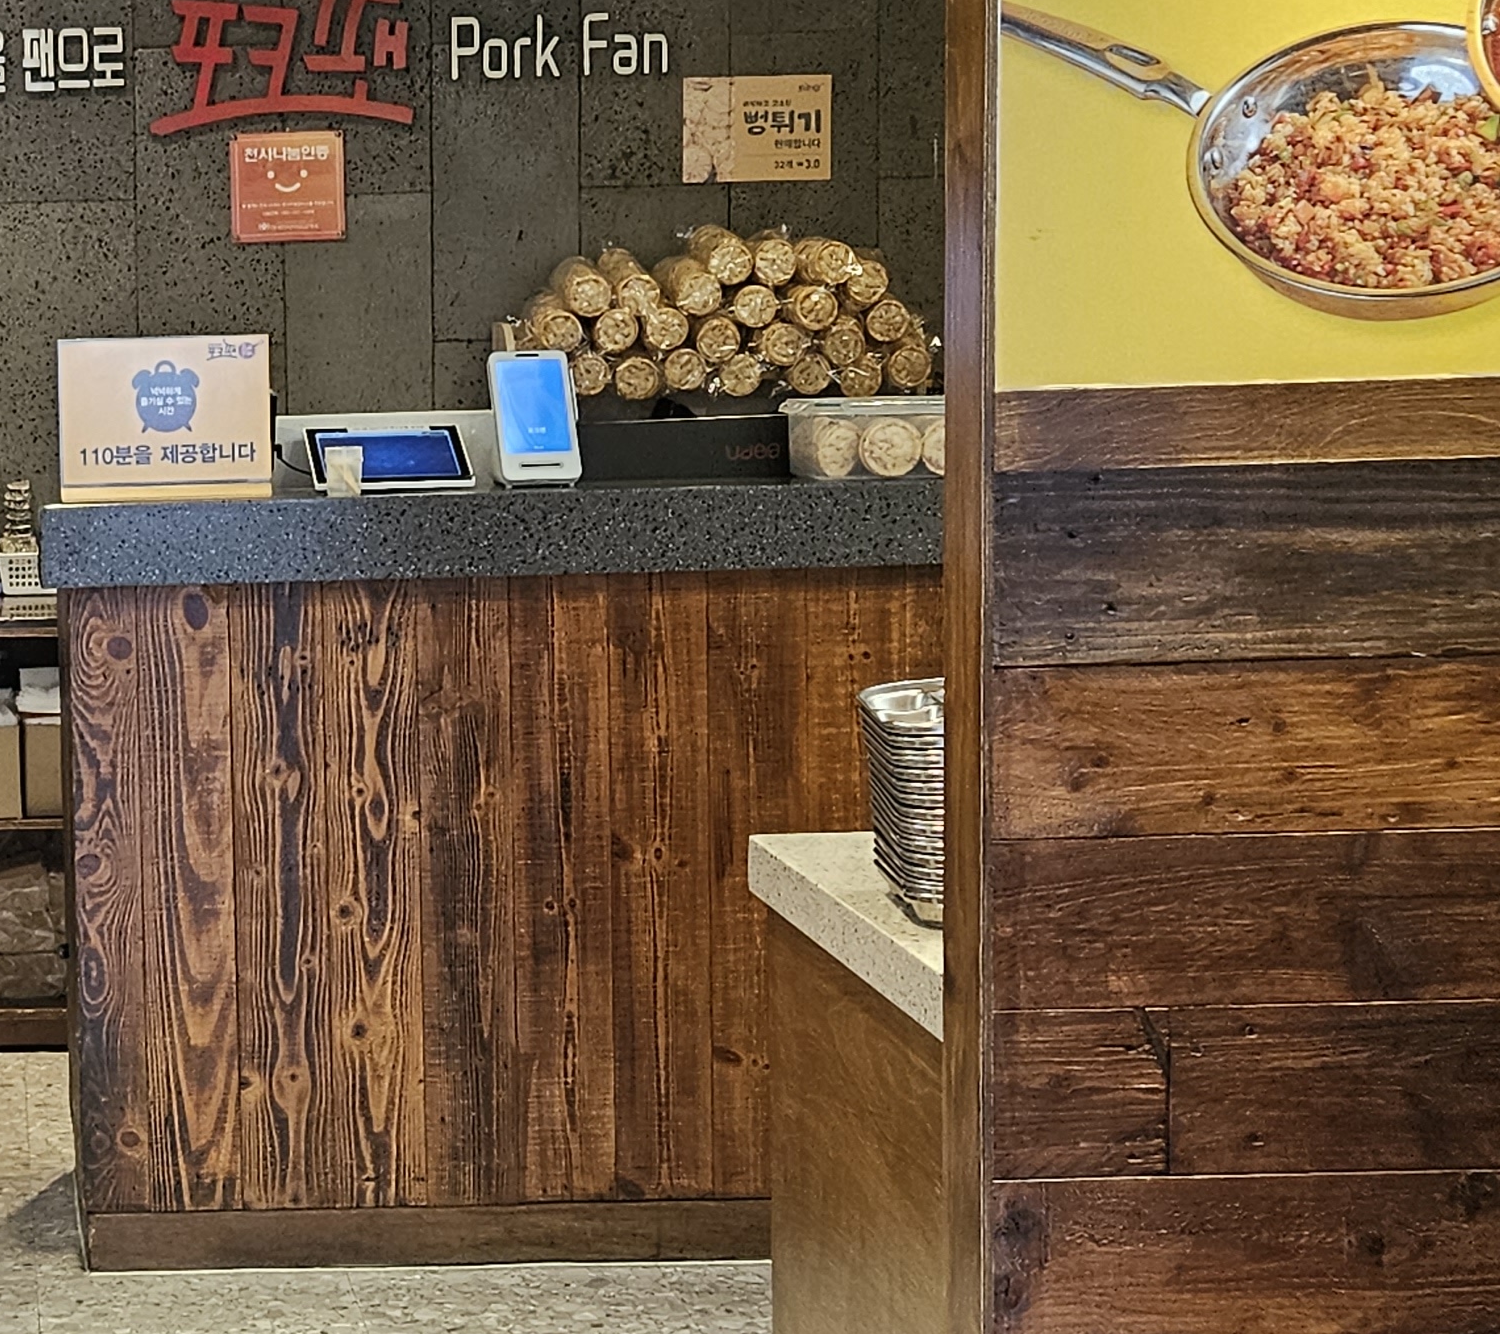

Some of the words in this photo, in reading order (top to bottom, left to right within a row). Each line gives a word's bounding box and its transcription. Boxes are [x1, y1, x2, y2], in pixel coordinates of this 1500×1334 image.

[22, 27, 125, 92] 팬으로
[451, 13, 561, 81] Pork
[582, 12, 669, 76] Fan
[79, 444, 153, 466] 110분을
[160, 441, 257, 465] 제공합니다
